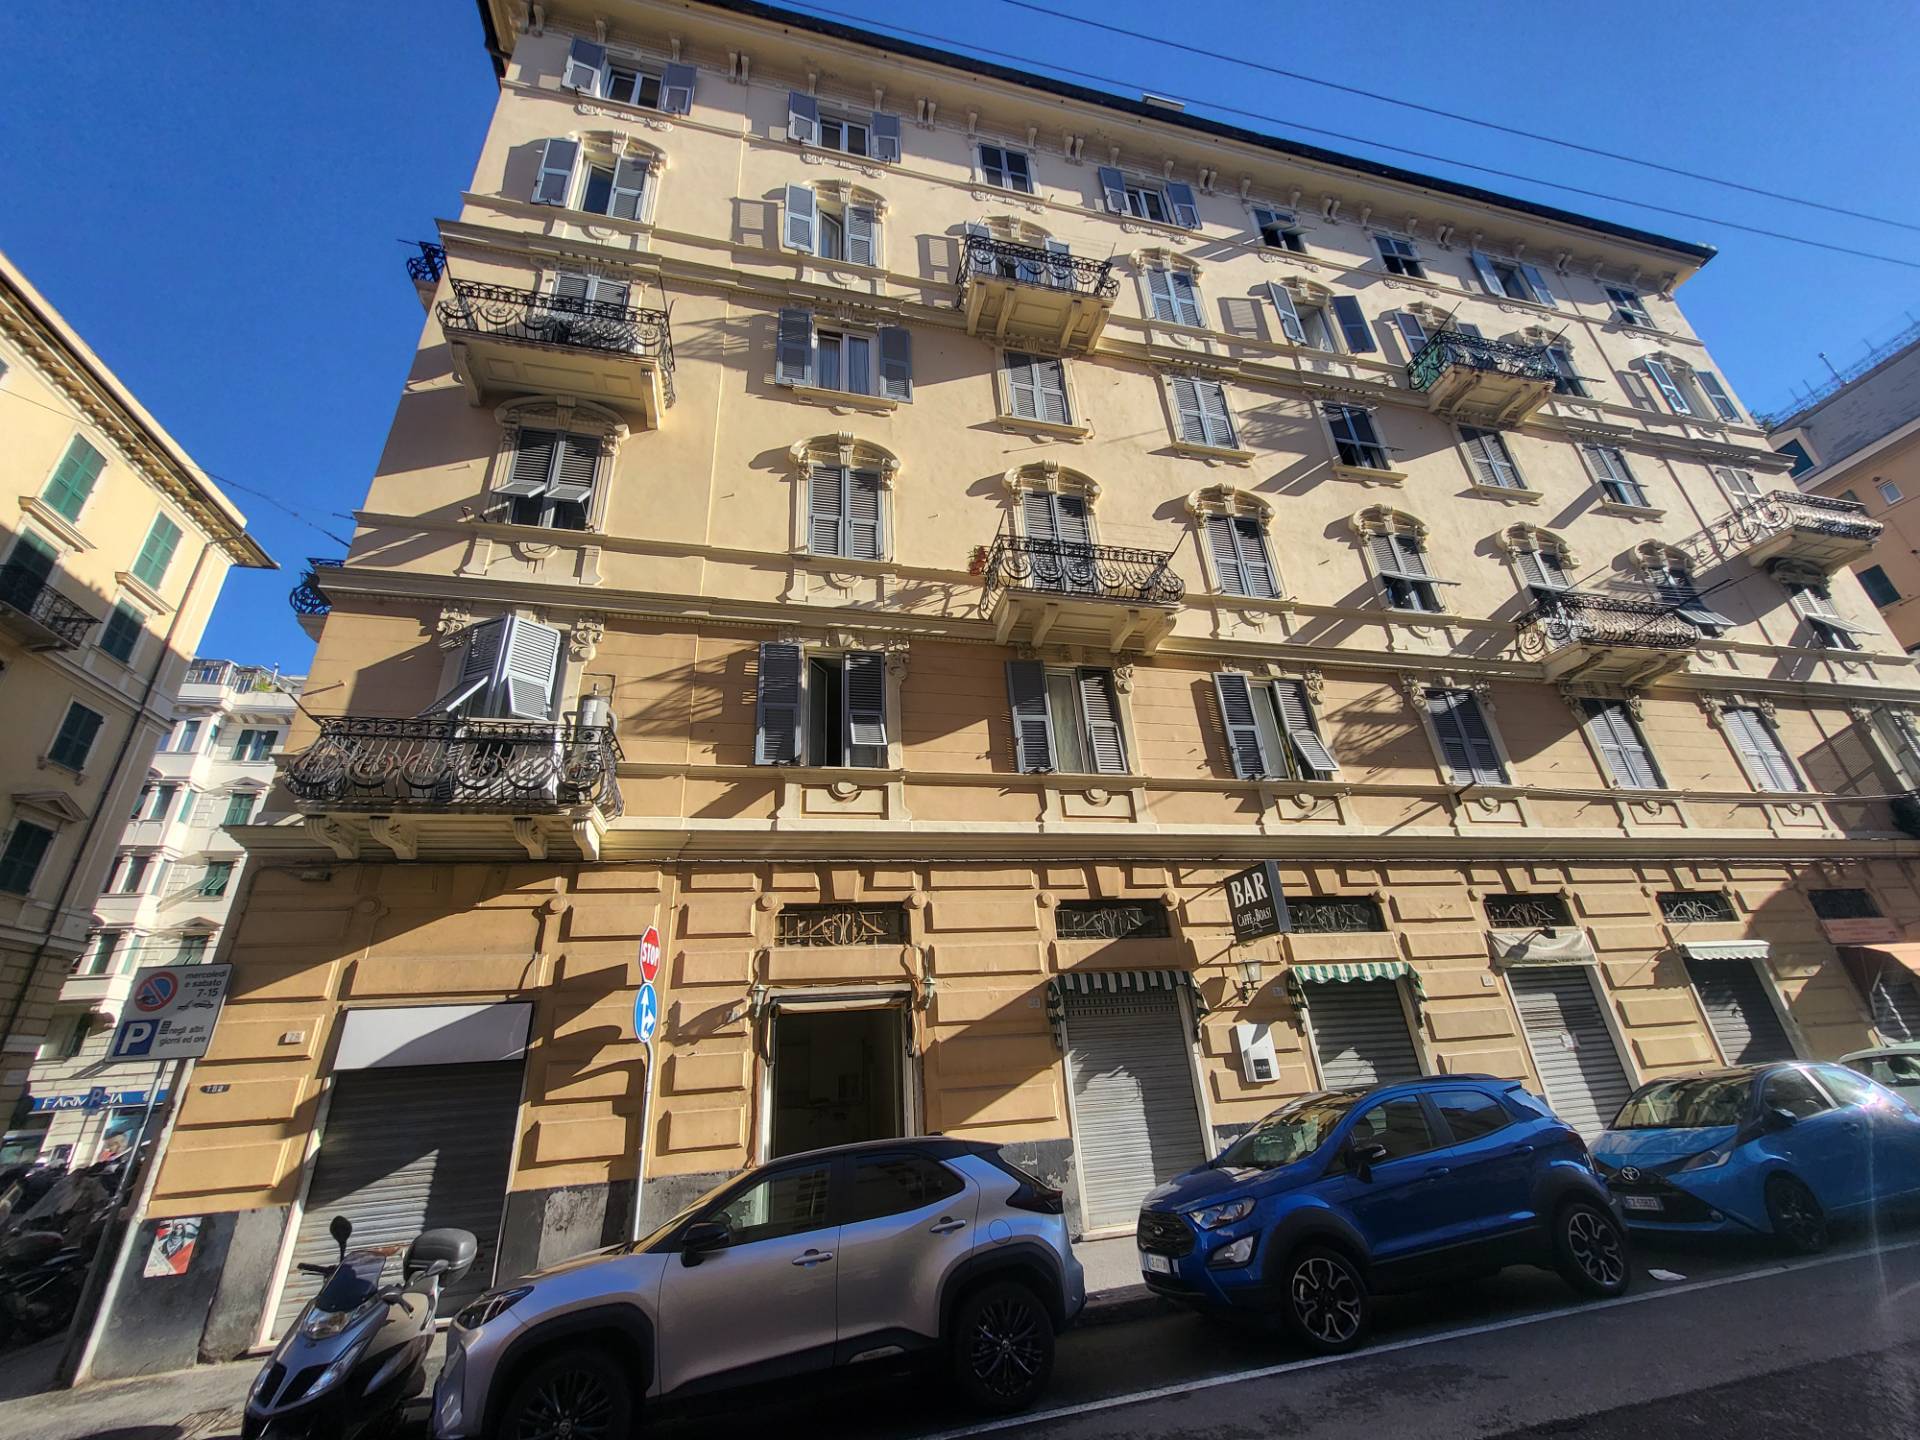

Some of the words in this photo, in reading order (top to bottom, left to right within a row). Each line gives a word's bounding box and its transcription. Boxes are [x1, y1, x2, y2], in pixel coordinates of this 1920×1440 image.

[1230, 872, 1268, 908] BAR
[642, 942, 660, 966] STOP
[191, 979, 222, 988] sabato
[197, 988, 218, 998] 7-15
[169, 1026, 187, 1035] negli
[189, 1025, 204, 1033] altri
[119, 1022, 153, 1054] P
[159, 1036, 180, 1047] giorni
[182, 1035, 192, 1044] ed
